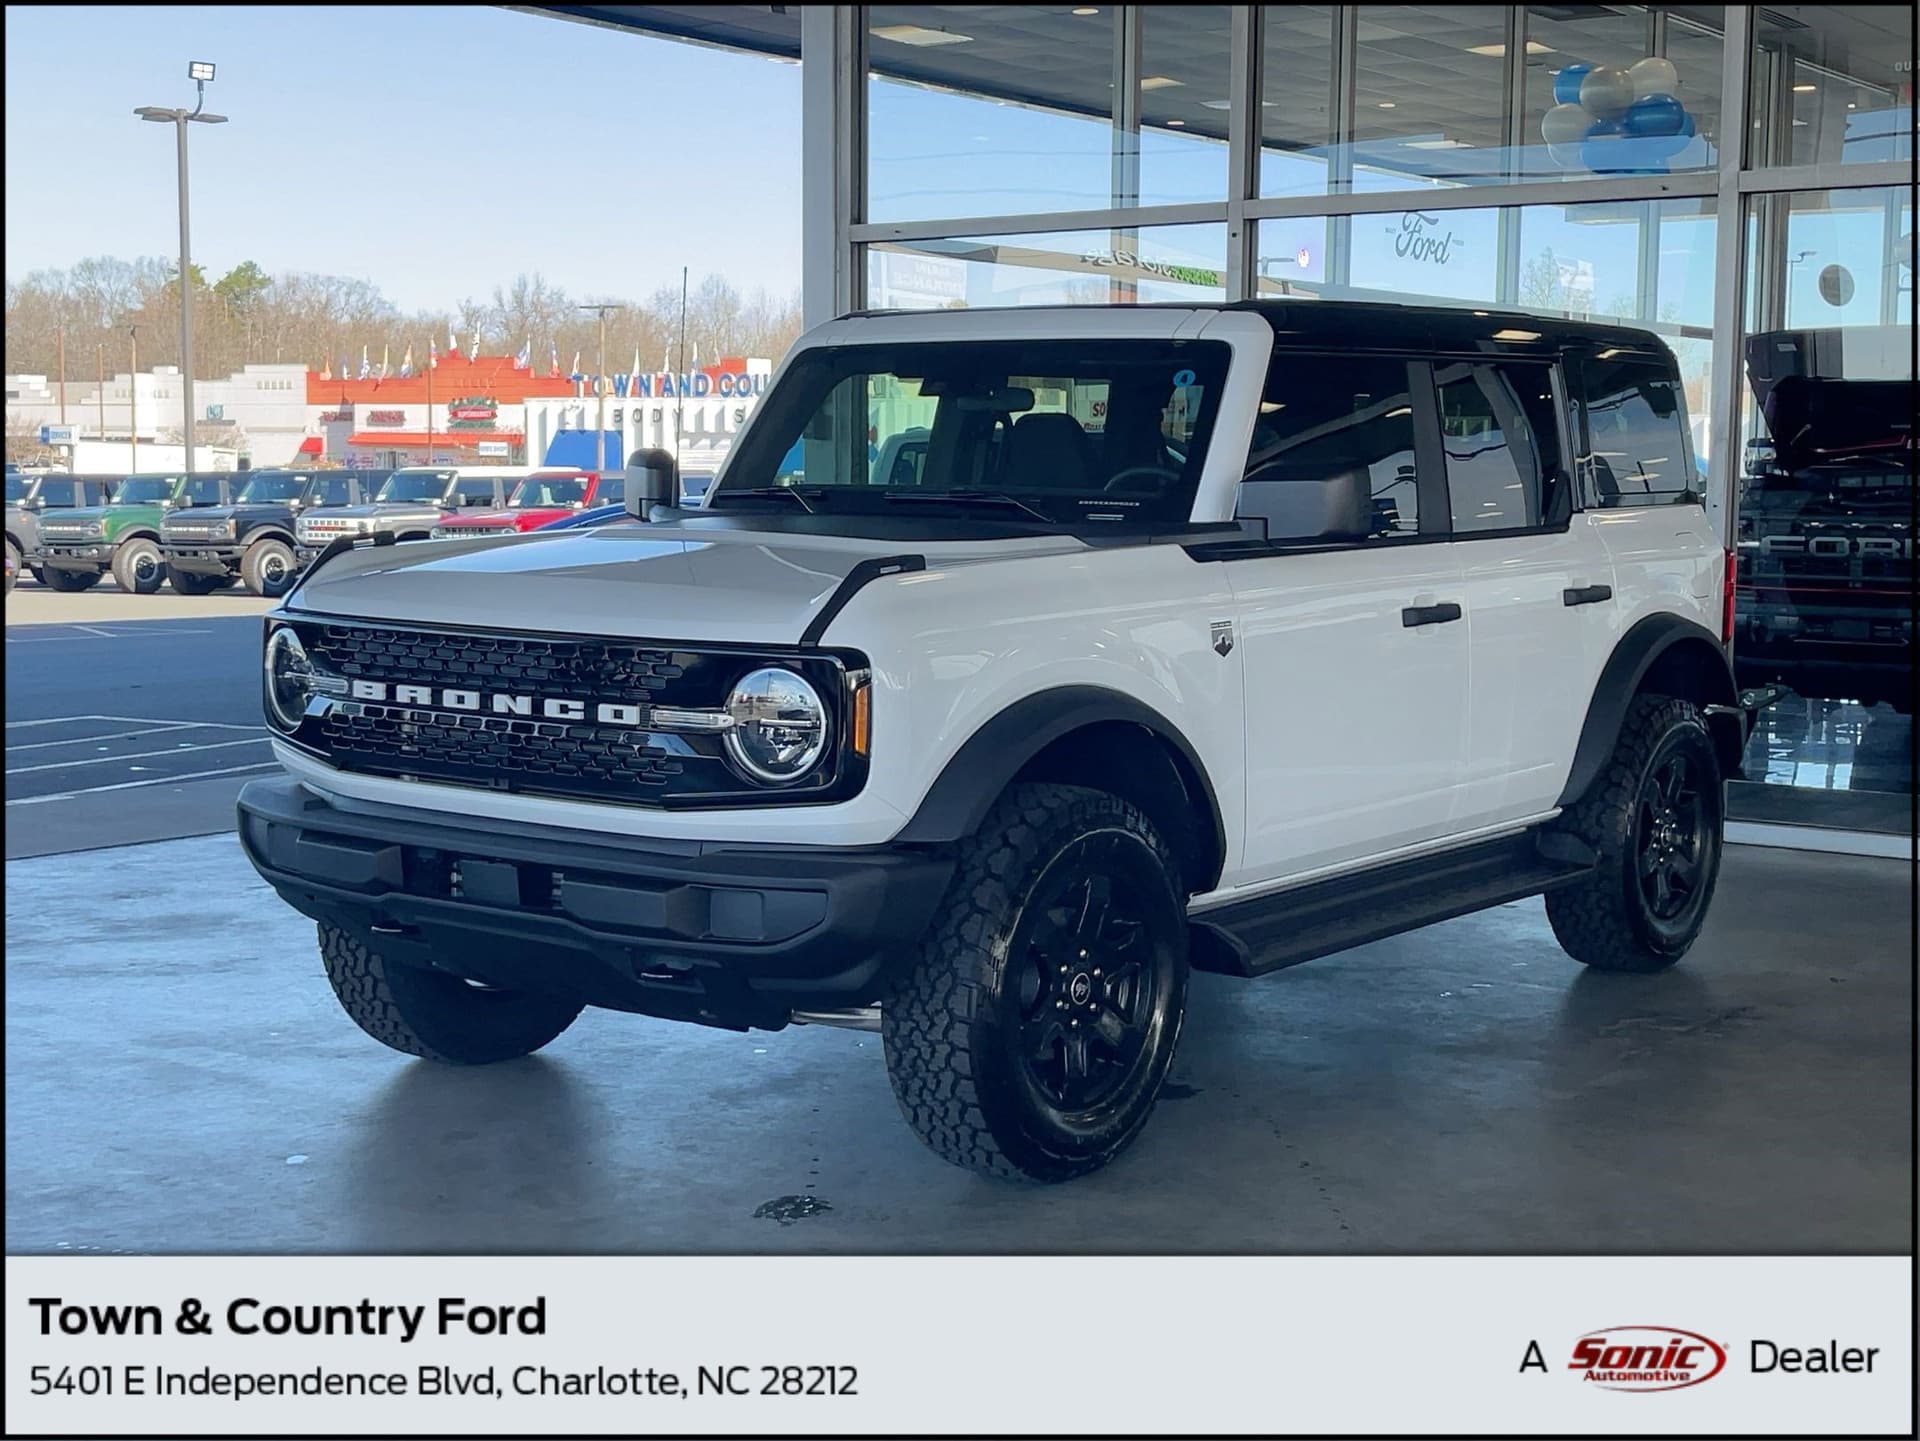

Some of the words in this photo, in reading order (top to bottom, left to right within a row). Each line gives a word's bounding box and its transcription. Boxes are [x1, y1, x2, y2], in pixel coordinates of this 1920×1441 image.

[1395, 211, 1452, 264] Ford
[662, 373, 710, 397] AND
[1760, 535, 1912, 559] FOR
[352, 679, 640, 725] BRONCO
